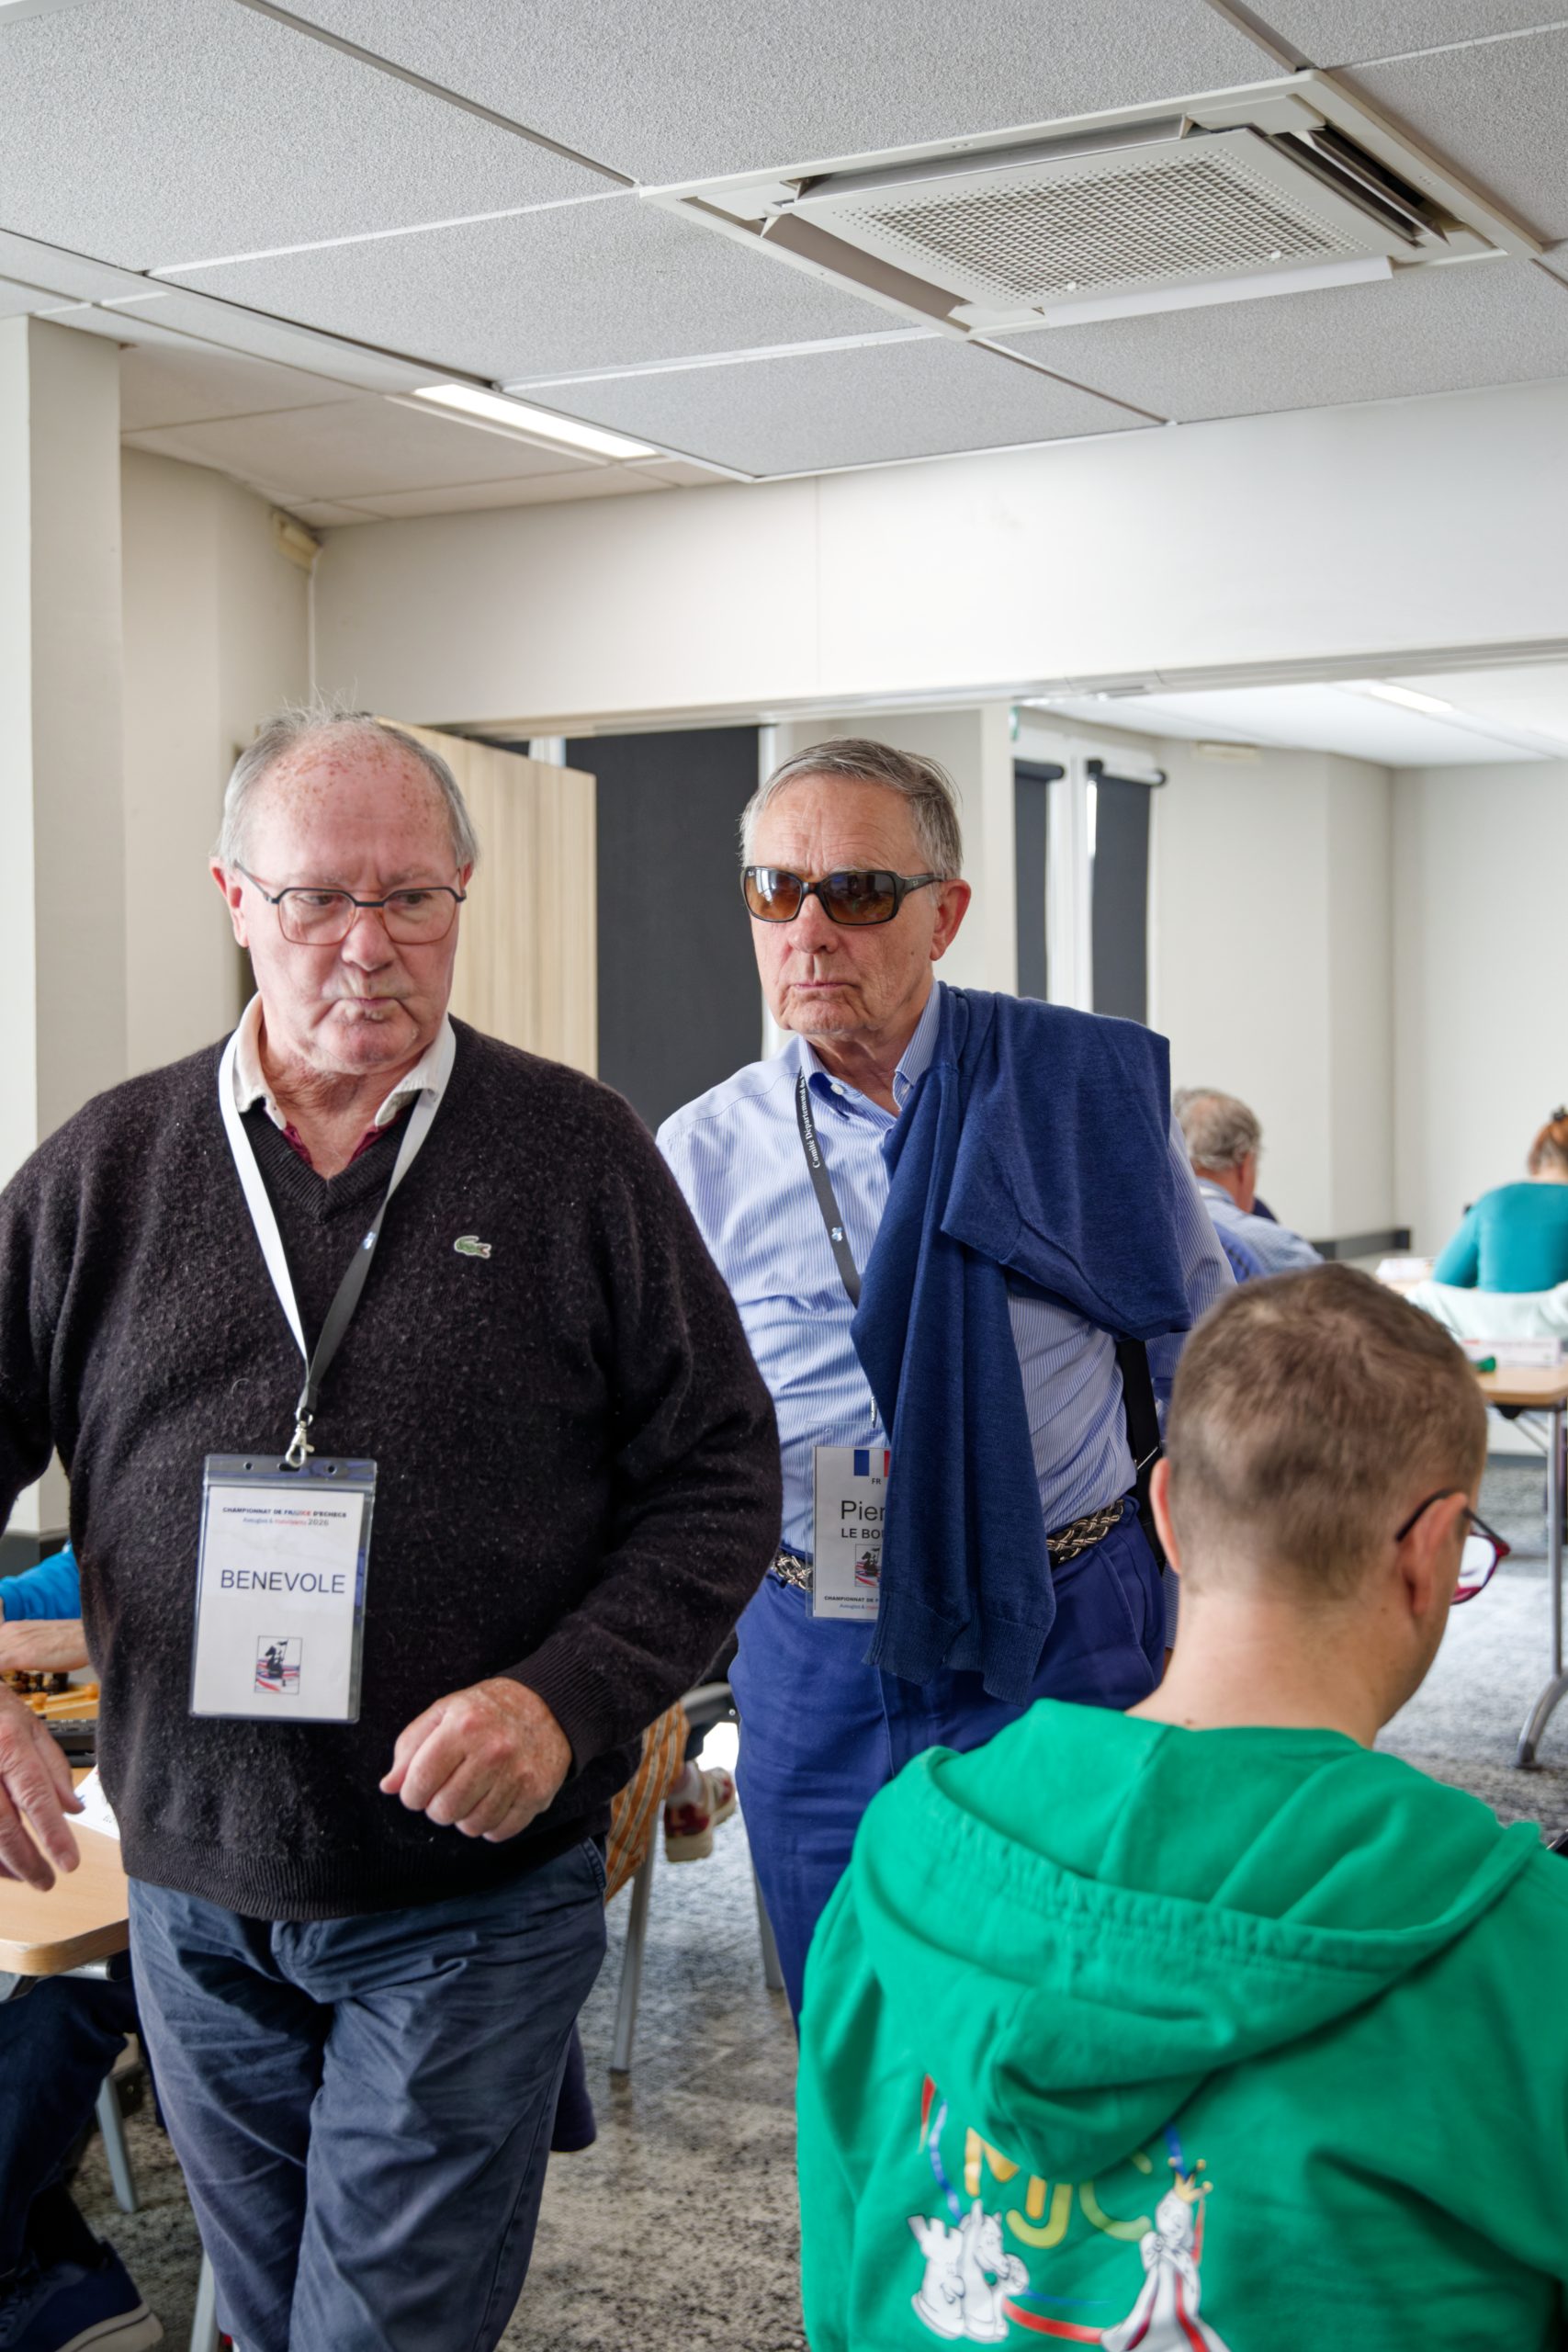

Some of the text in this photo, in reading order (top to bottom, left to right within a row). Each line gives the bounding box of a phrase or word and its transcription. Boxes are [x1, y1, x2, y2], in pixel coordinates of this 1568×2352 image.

[798, 1089, 813, 1140] Départemental
[807, 1140, 820, 1169] Comité
[222, 1507, 272, 1515] CHAMPIONNAT
[840, 1528, 857, 1539] LE
[220, 1569, 346, 1594] BENEVOLE
